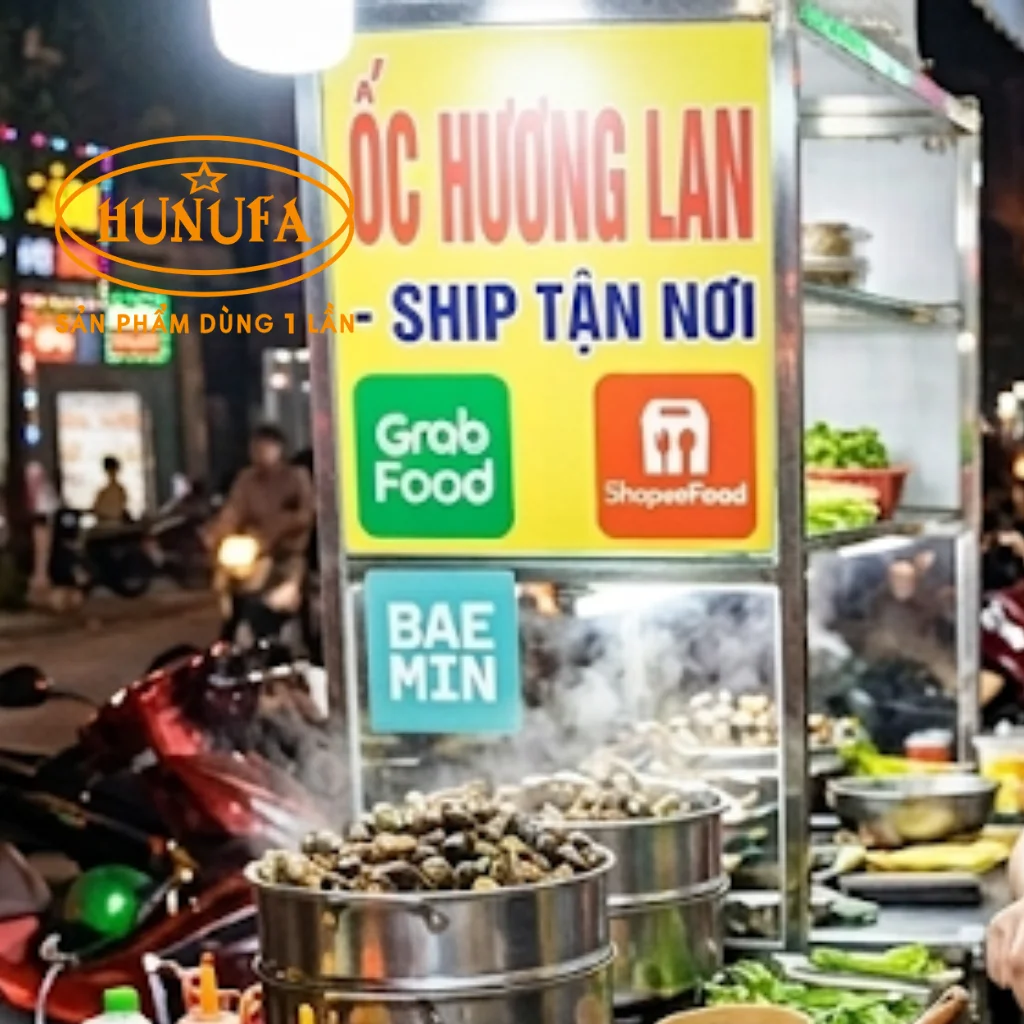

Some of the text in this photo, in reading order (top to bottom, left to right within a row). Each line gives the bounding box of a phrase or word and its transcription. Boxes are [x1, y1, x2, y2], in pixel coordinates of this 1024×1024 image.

[350, 58, 753, 245] ỐC HƯƠNG LAN
[392, 283, 517, 341] SHIP
[535, 268, 640, 354] TẬN
[663, 276, 755, 340] NƠI
[374, 407, 491, 457] Grab
[374, 459, 494, 504] Food
[605, 479, 749, 510] ShopeeFood
[386, 602, 496, 649] BAE
[389, 655, 498, 702] MIN
